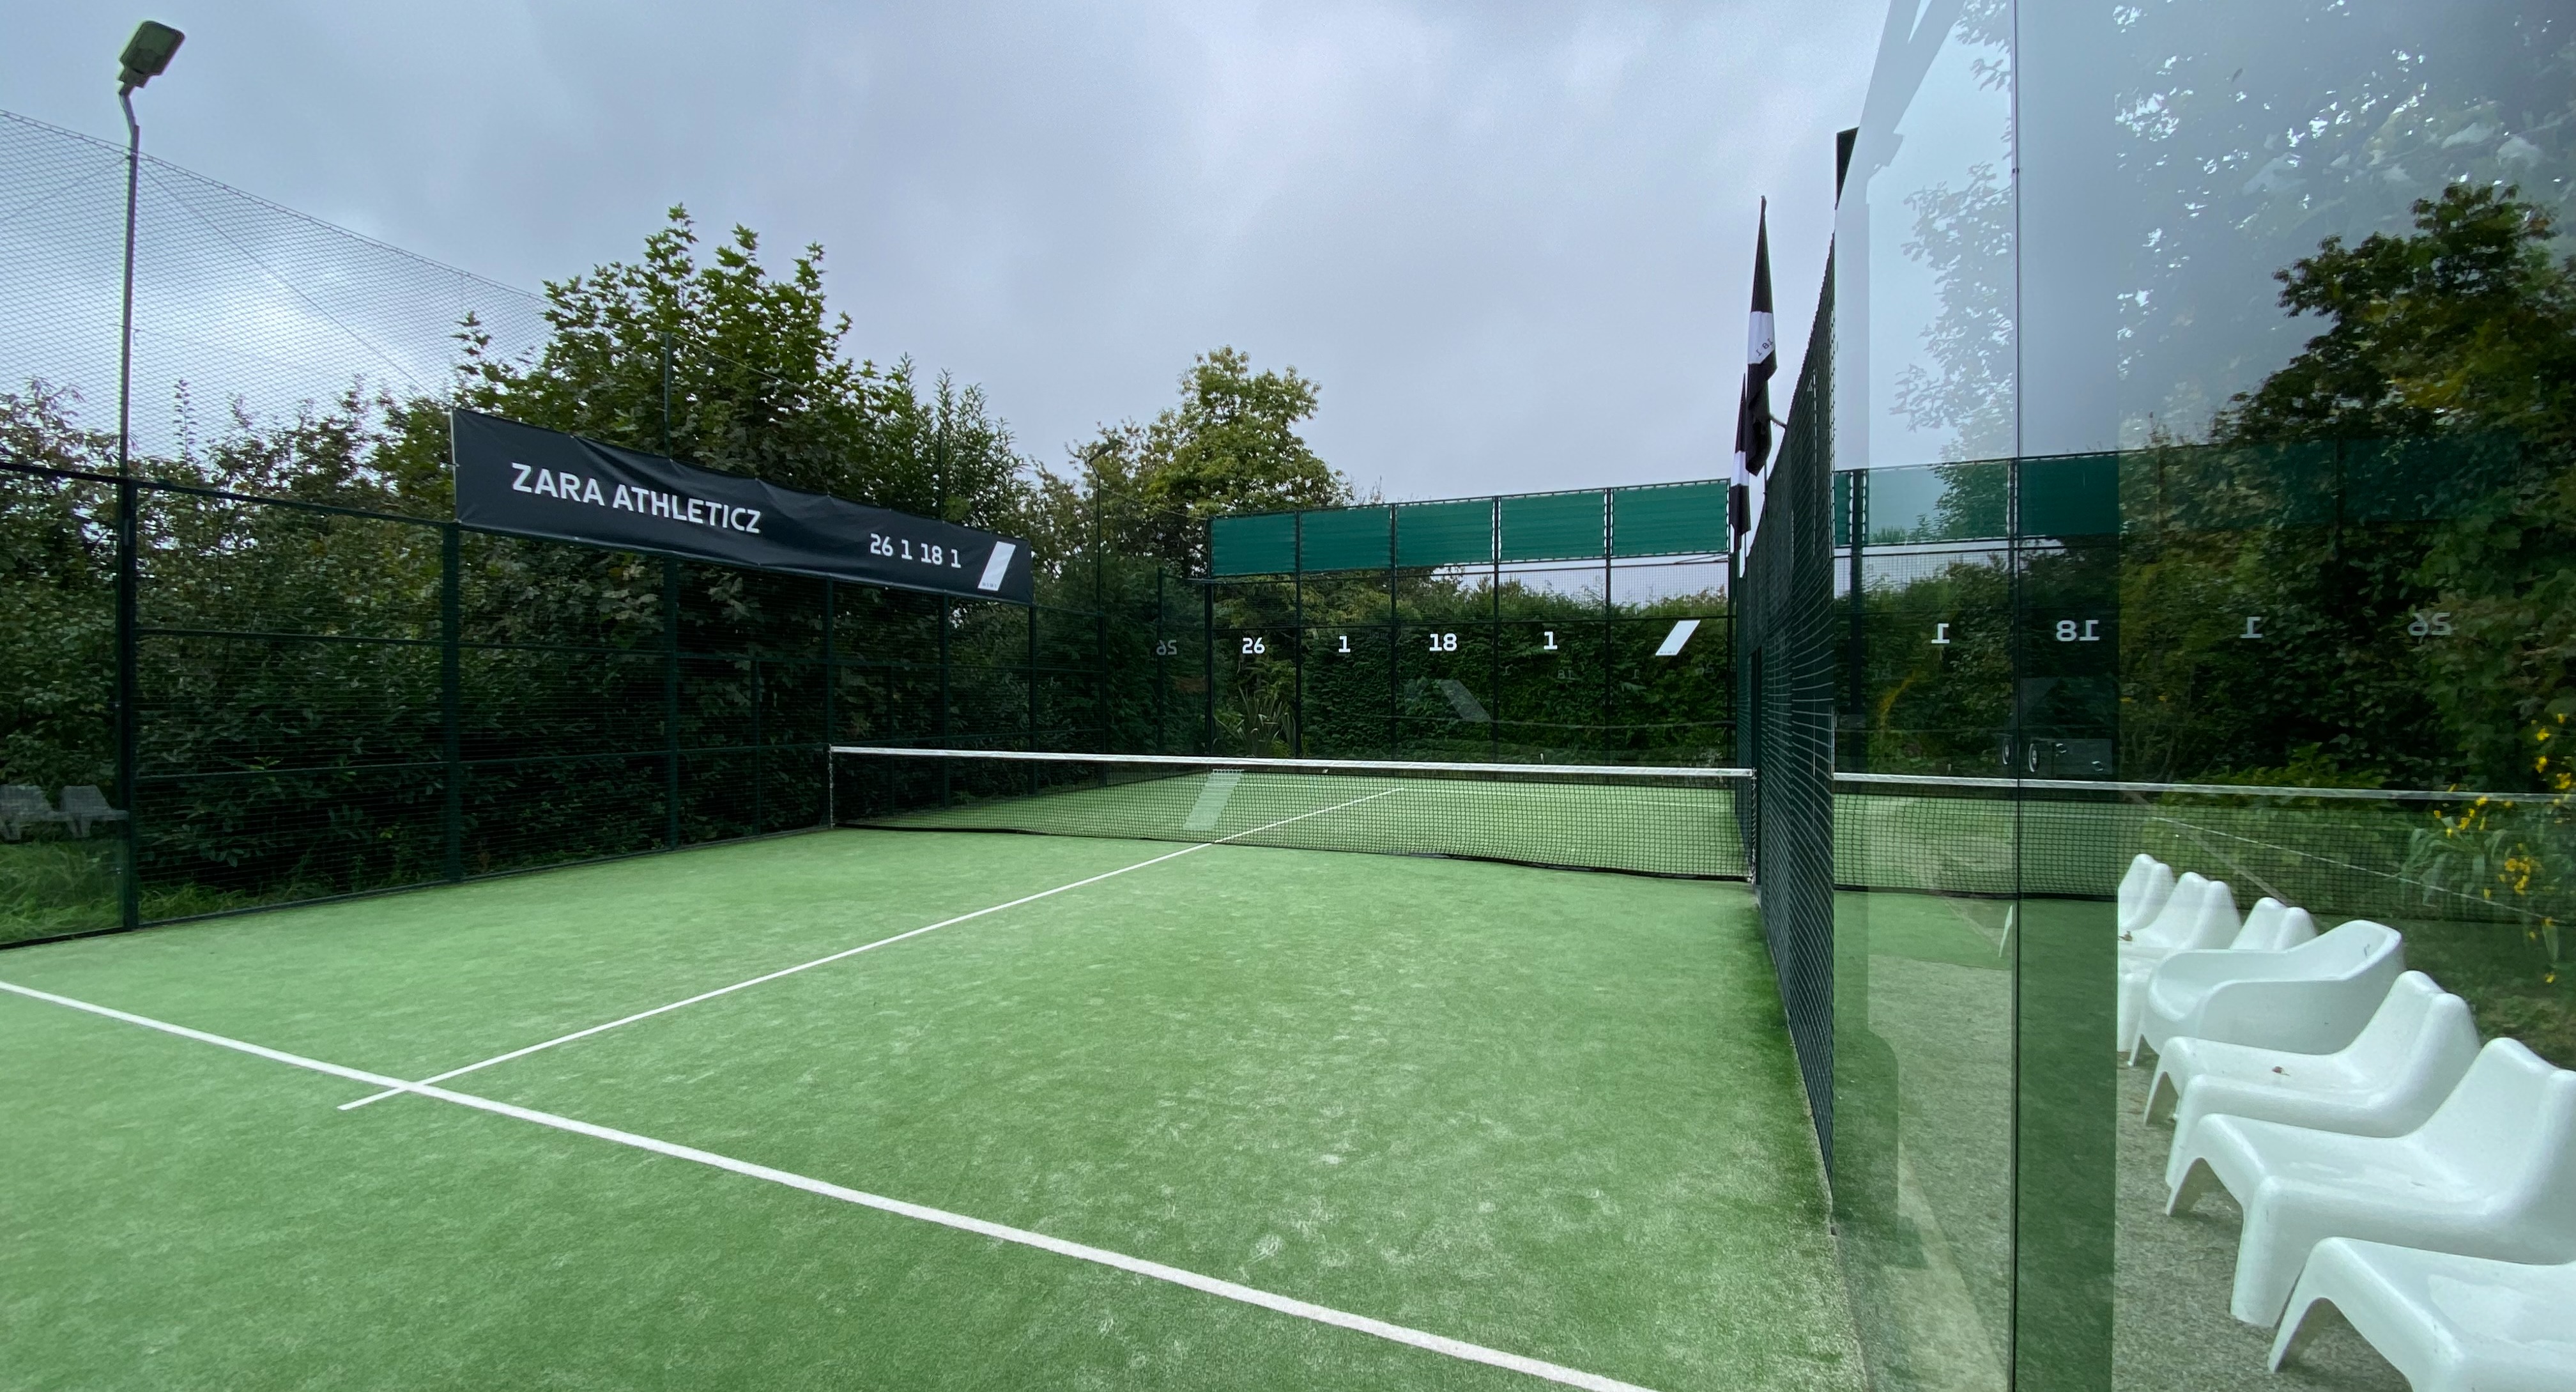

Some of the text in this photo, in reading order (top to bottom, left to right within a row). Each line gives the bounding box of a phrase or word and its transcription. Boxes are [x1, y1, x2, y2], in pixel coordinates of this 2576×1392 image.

[512, 462, 761, 534] ZARA ATHLETICZ
[870, 533, 962, 568] 26 1 18 1
[1242, 637, 1265, 654] 26
[1338, 635, 1351, 653] 1
[1429, 633, 1457, 651] 18
[1544, 631, 1558, 650] 1
